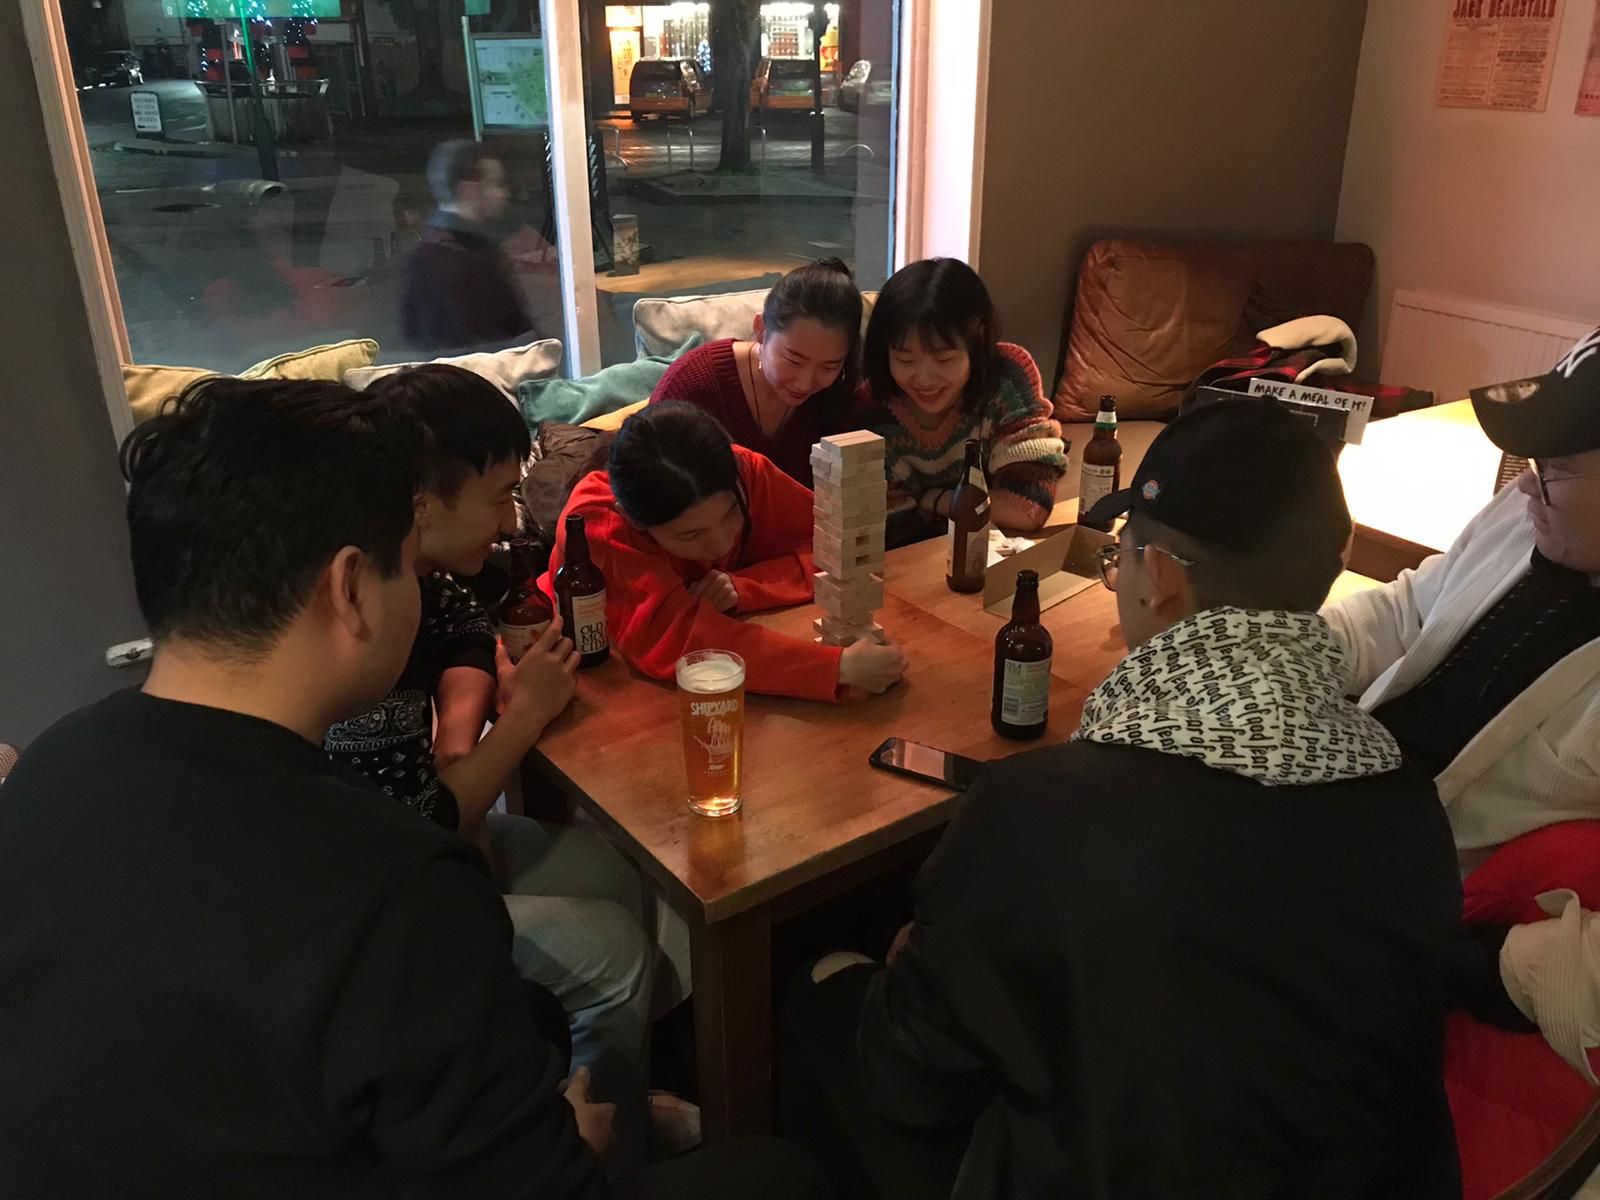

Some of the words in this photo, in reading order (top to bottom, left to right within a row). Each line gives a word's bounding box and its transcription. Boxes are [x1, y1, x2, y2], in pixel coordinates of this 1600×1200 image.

[1254, 384, 1286, 397] MAKE
[1289, 389, 1297, 400] A
[1300, 391, 1330, 405] MEAL
[1334, 398, 1348, 409] OF
[690, 700, 738, 716] SHIPYARD
[1148, 725, 1182, 751] fear
[1239, 716, 1275, 741] god
[1209, 736, 1246, 758] god
[1240, 744, 1279, 771] fear
[1299, 736, 1324, 763] god
